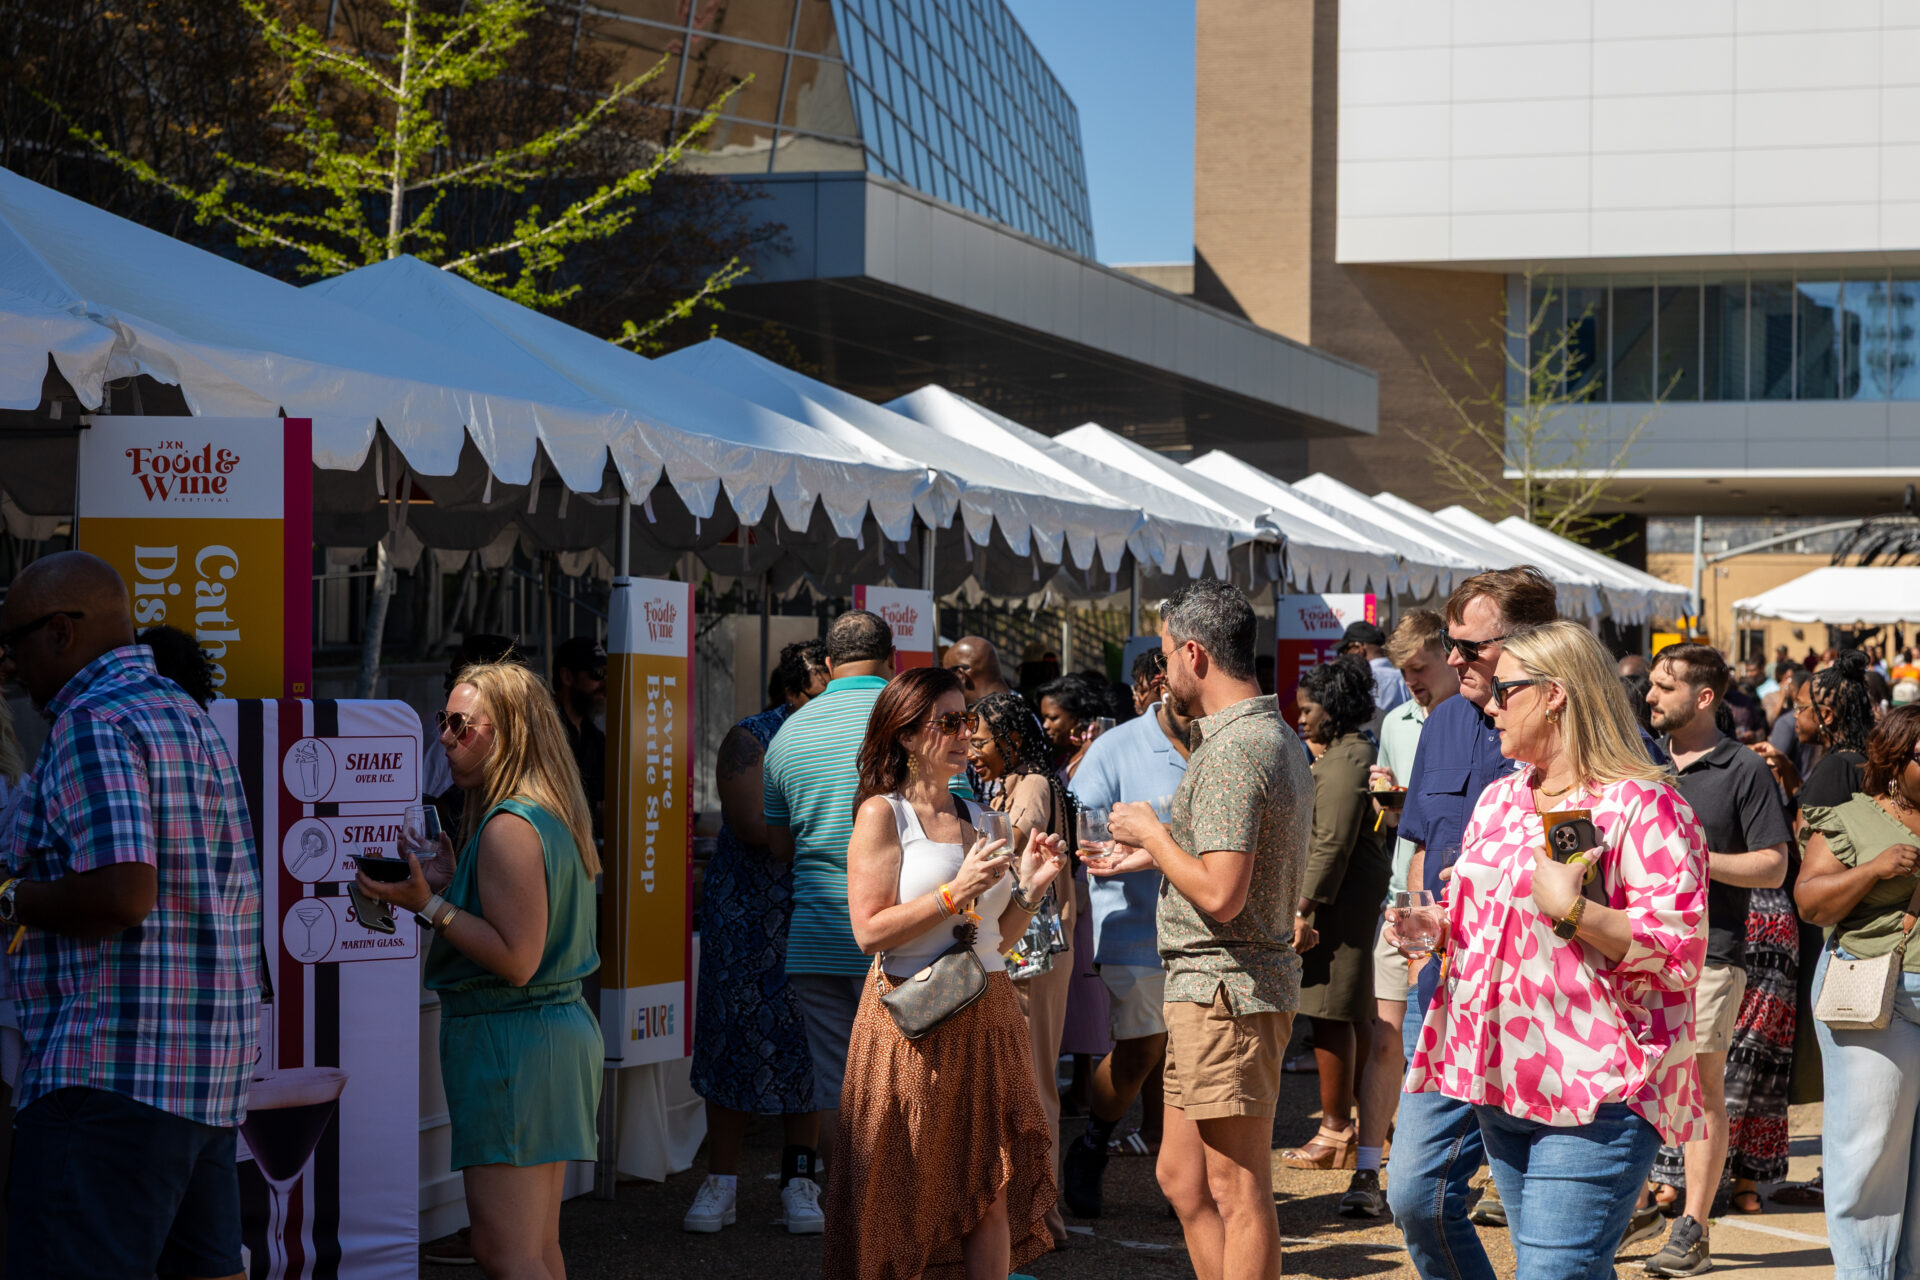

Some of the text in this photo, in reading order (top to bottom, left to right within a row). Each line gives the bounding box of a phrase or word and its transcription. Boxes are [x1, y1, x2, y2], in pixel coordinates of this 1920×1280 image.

[158, 441, 183, 449] JXN
[138, 473, 228, 502] Wine
[134, 544, 182, 637] Dis
[648, 621, 673, 642] Wine
[1303, 620, 1339, 631] Wine
[662, 675, 677, 809] Levure
[345, 752, 403, 770] SHAKE
[355, 773, 395, 783] OVER ICE.
[640, 674, 660, 894] Bottle Shop
[341, 937, 405, 950] MARTINI GLASS.
[631, 1003, 675, 1041] LEVURE
